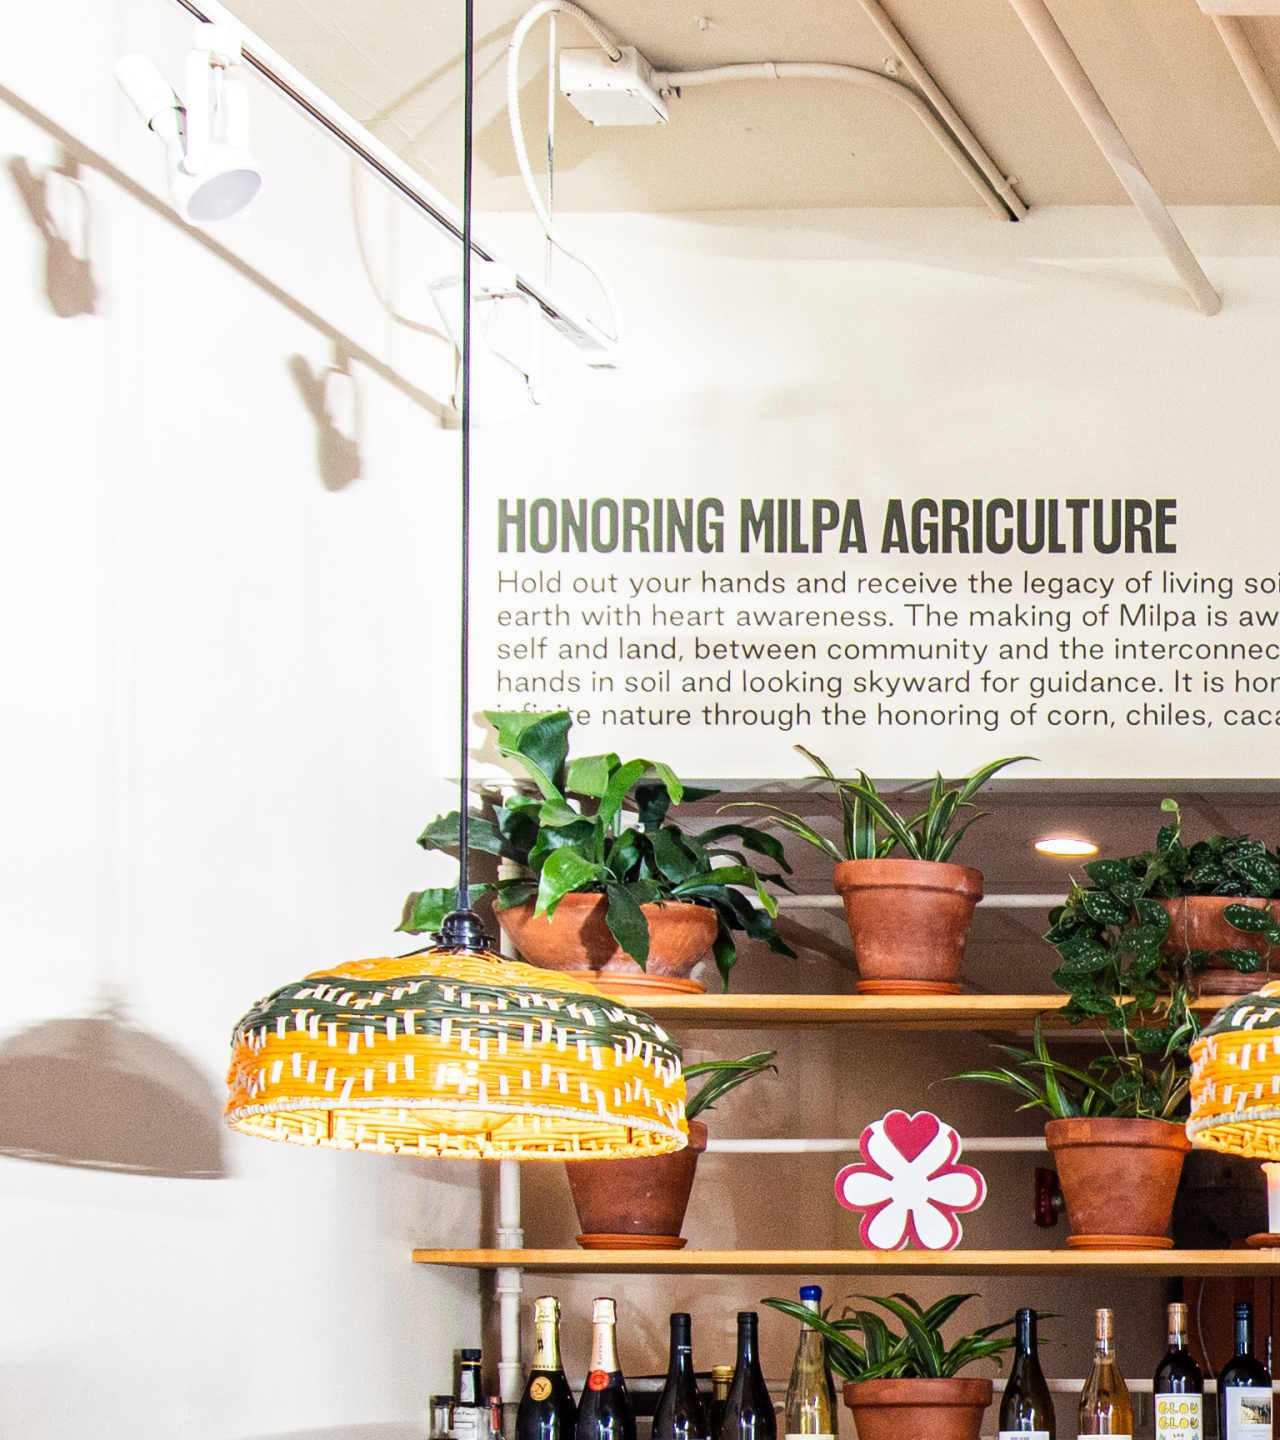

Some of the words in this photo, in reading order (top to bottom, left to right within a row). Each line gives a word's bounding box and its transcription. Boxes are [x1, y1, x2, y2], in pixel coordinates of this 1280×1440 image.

[497, 496, 725, 555] HONORING
[739, 497, 869, 555] MILPA
[879, 497, 1178, 556] AGRICULTURE
[498, 569, 561, 594] Hold
[572, 573, 619, 594] out
[628, 576, 693, 599] your
[701, 569, 786, 595] hands
[796, 569, 847, 595] and
[857, 571, 958, 595] receive
[967, 569, 1014, 595] the
[1023, 569, 1116, 600] legacy
[1124, 569, 1153, 595] of
[1162, 569, 1234, 600] living
[497, 603, 571, 627] earth
[580, 603, 641, 627] with
[652, 603, 726, 627] heart
[736, 609, 895, 628] awareness.
[903, 602, 959, 628] The
[969, 602, 1071, 633] making
[1081, 602, 1111, 628] of
[1119, 602, 1198, 633] Milpa
[1206, 604, 1229, 628] is
[497, 635, 549, 660] self
[557, 636, 608, 660] and
[619, 635, 684, 663] land,
[694, 635, 817, 661] between
[826, 637, 989, 666] community
[998, 635, 1049, 661] and
[1058, 635, 1105, 661] the
[497, 669, 581, 694] hands
[591, 670, 614, 693] in
[624, 668, 671, 693] soil
[681, 668, 732, 694] and
[742, 668, 843, 700] looking
[852, 668, 971, 699] skyward
[979, 669, 1021, 694] for
[1029, 668, 1164, 700] guidance.
[1174, 668, 1193, 694] It
[1202, 669, 1225, 694] is
[602, 705, 692, 727] nature
[700, 701, 811, 732] through
[820, 701, 867, 727] the
[877, 701, 1000, 732] honoring
[1009, 702, 1038, 727] of
[1046, 708, 1116, 729] corn,
[1125, 701, 1213, 729] chiles,
